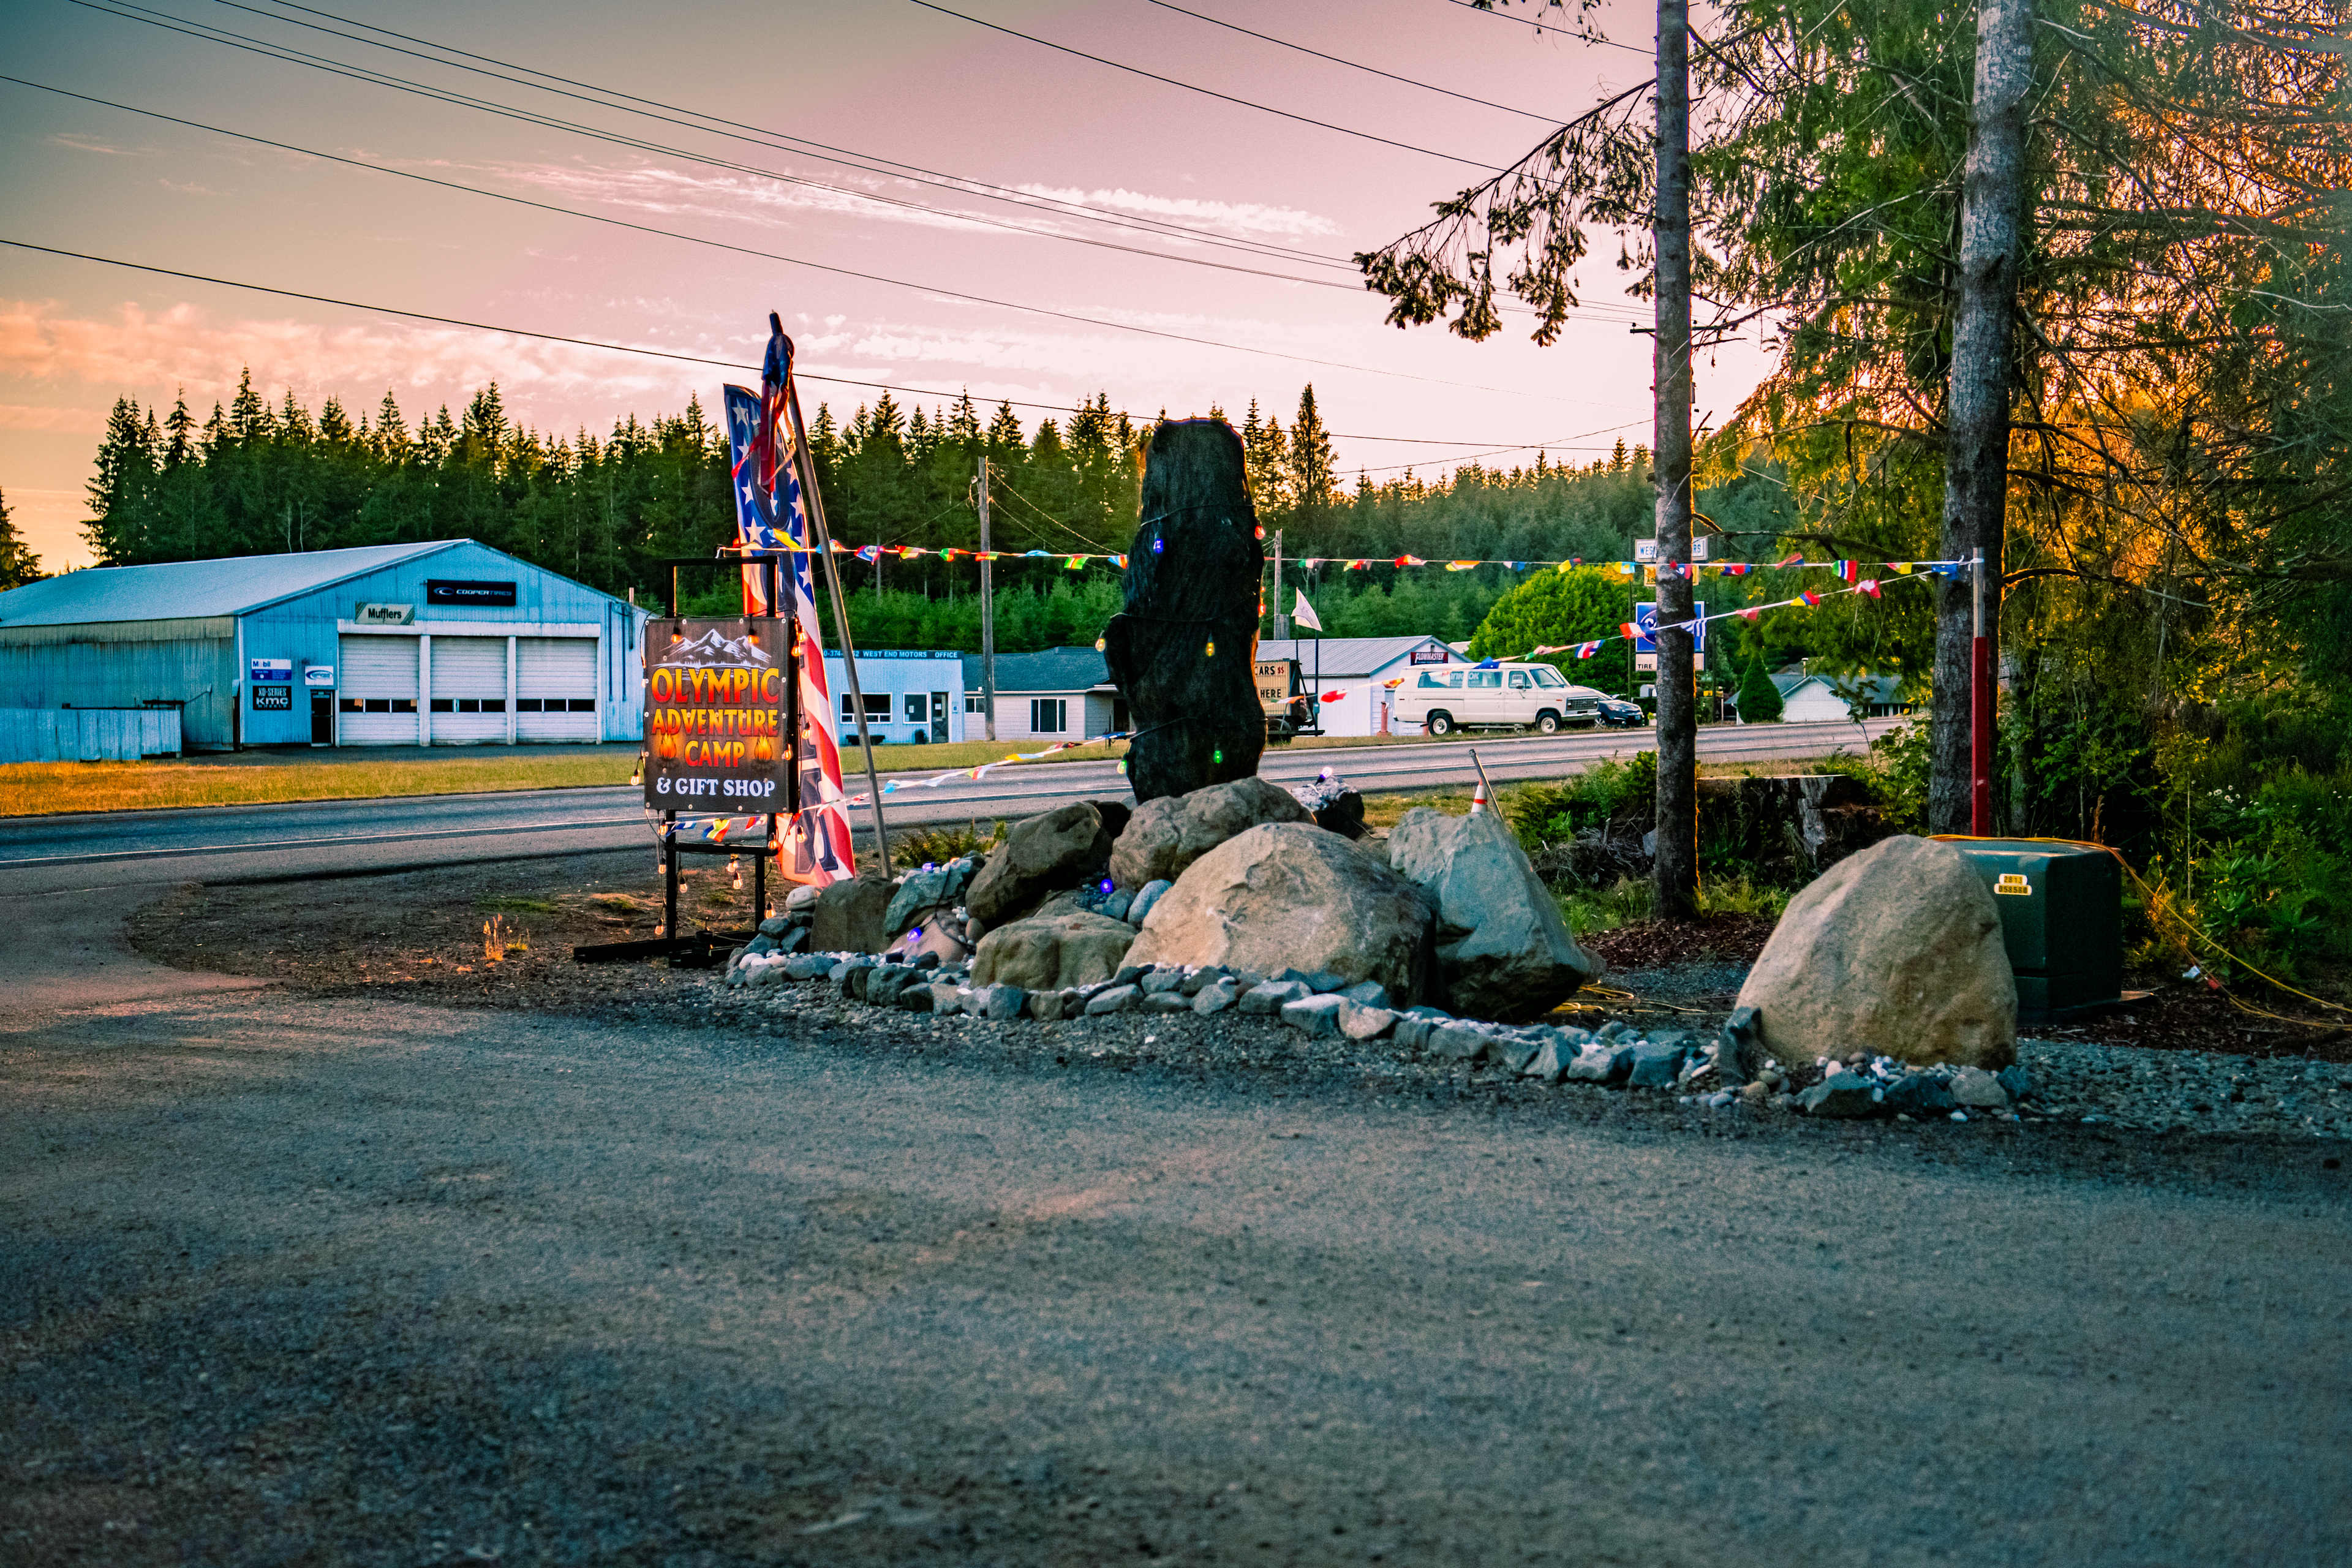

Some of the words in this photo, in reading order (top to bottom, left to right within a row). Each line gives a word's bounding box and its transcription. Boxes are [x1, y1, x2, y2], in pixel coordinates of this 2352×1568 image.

[1640, 546, 1656, 554] WES
[368, 608, 402, 622] Mufflers
[652, 668, 779, 703] OLYMPIC
[1261, 689, 1281, 698] HERE
[651, 709, 778, 736] ADVENTURE
[685, 741, 745, 767] CAMP
[656, 777, 670, 794] &
[676, 778, 718, 796] GIFT
[723, 779, 775, 797] SHOP
